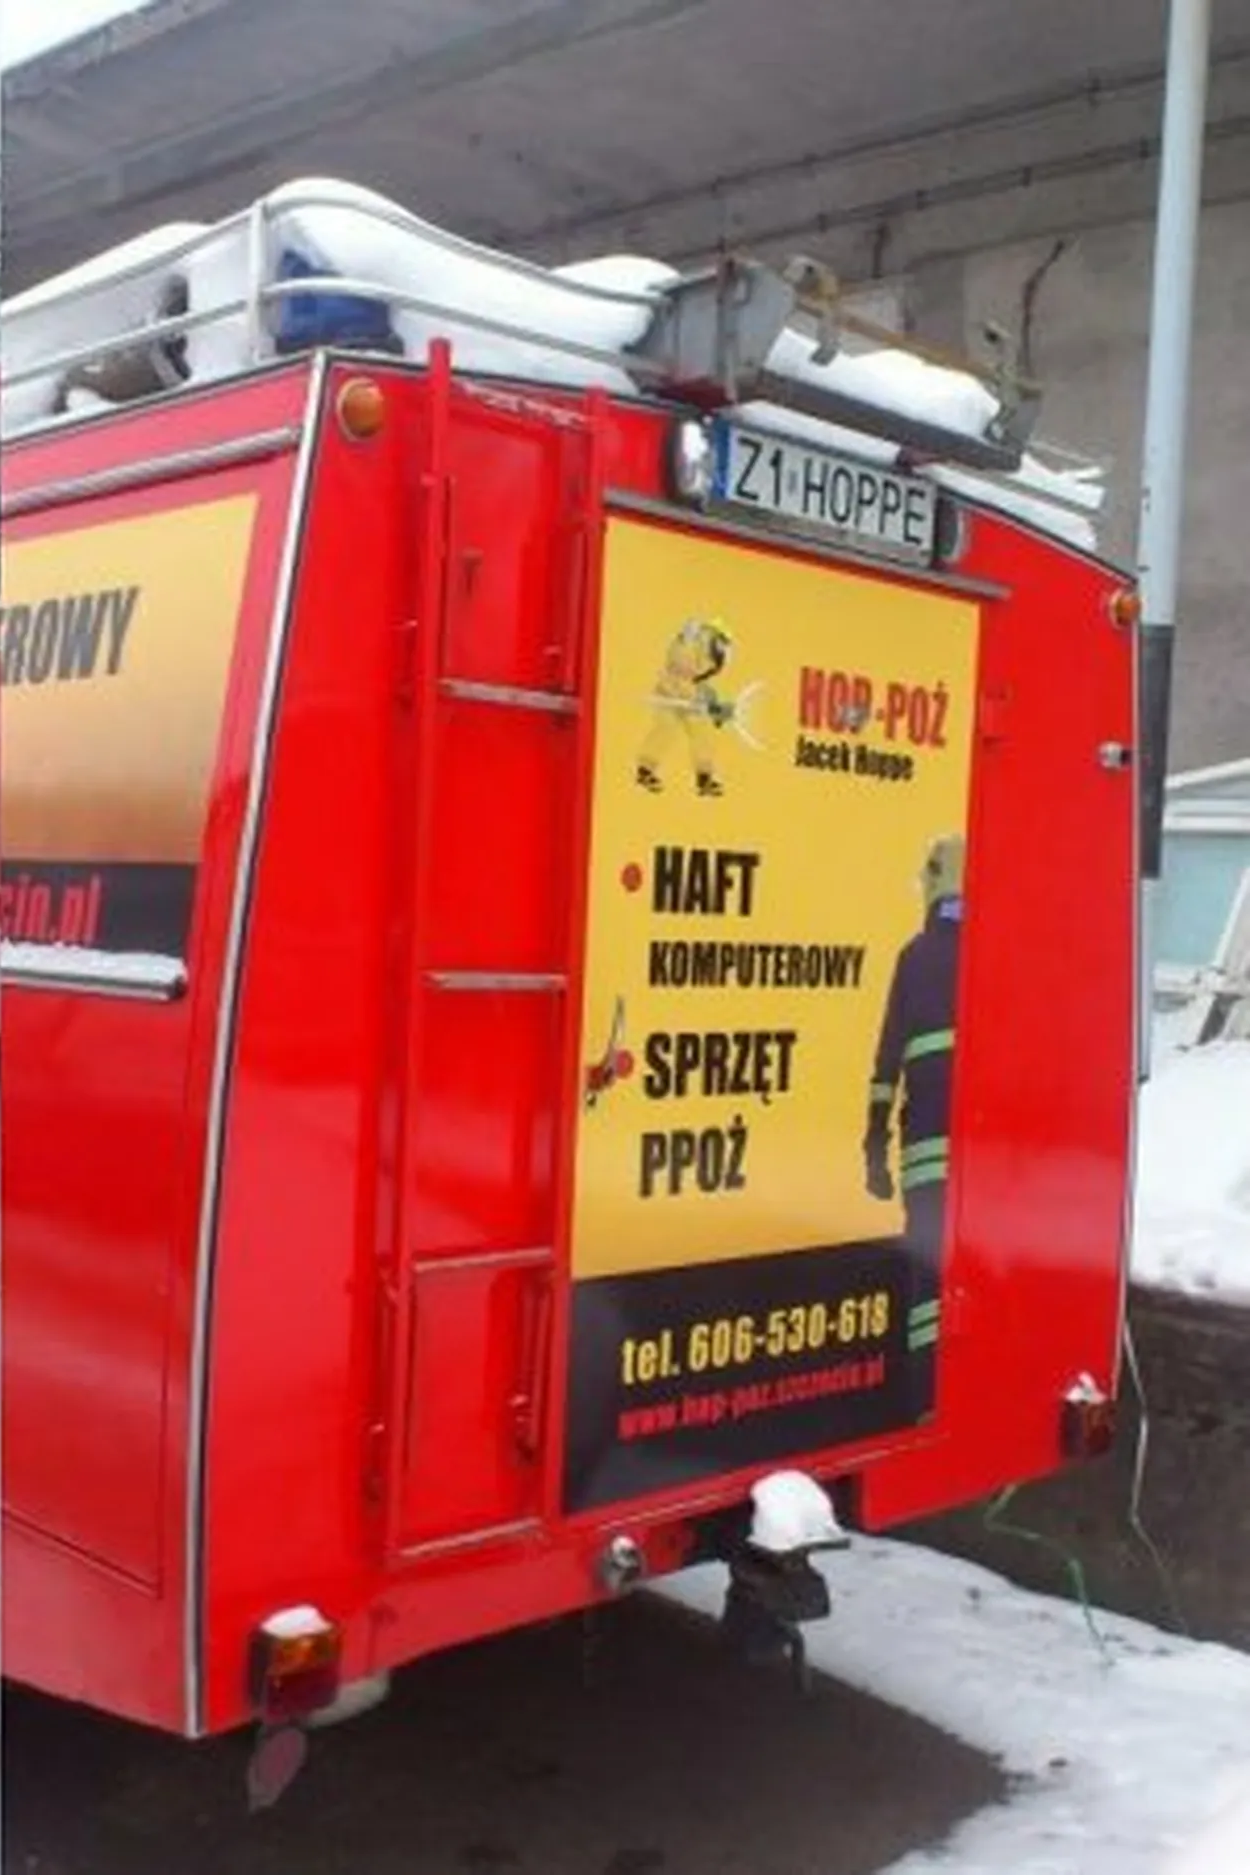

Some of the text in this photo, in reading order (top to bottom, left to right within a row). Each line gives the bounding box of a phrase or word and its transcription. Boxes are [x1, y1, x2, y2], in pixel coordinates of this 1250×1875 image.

[735, 437, 925, 545] Z1 HOPPE
[0, 586, 139, 685] ROWY
[653, 847, 759, 916] HAFT
[649, 940, 866, 989] KOMPUTEROWY
[644, 1031, 796, 1105] SPRZĘT
[639, 1114, 747, 1198] PPOŻ
[621, 1330, 680, 1385] tel.
